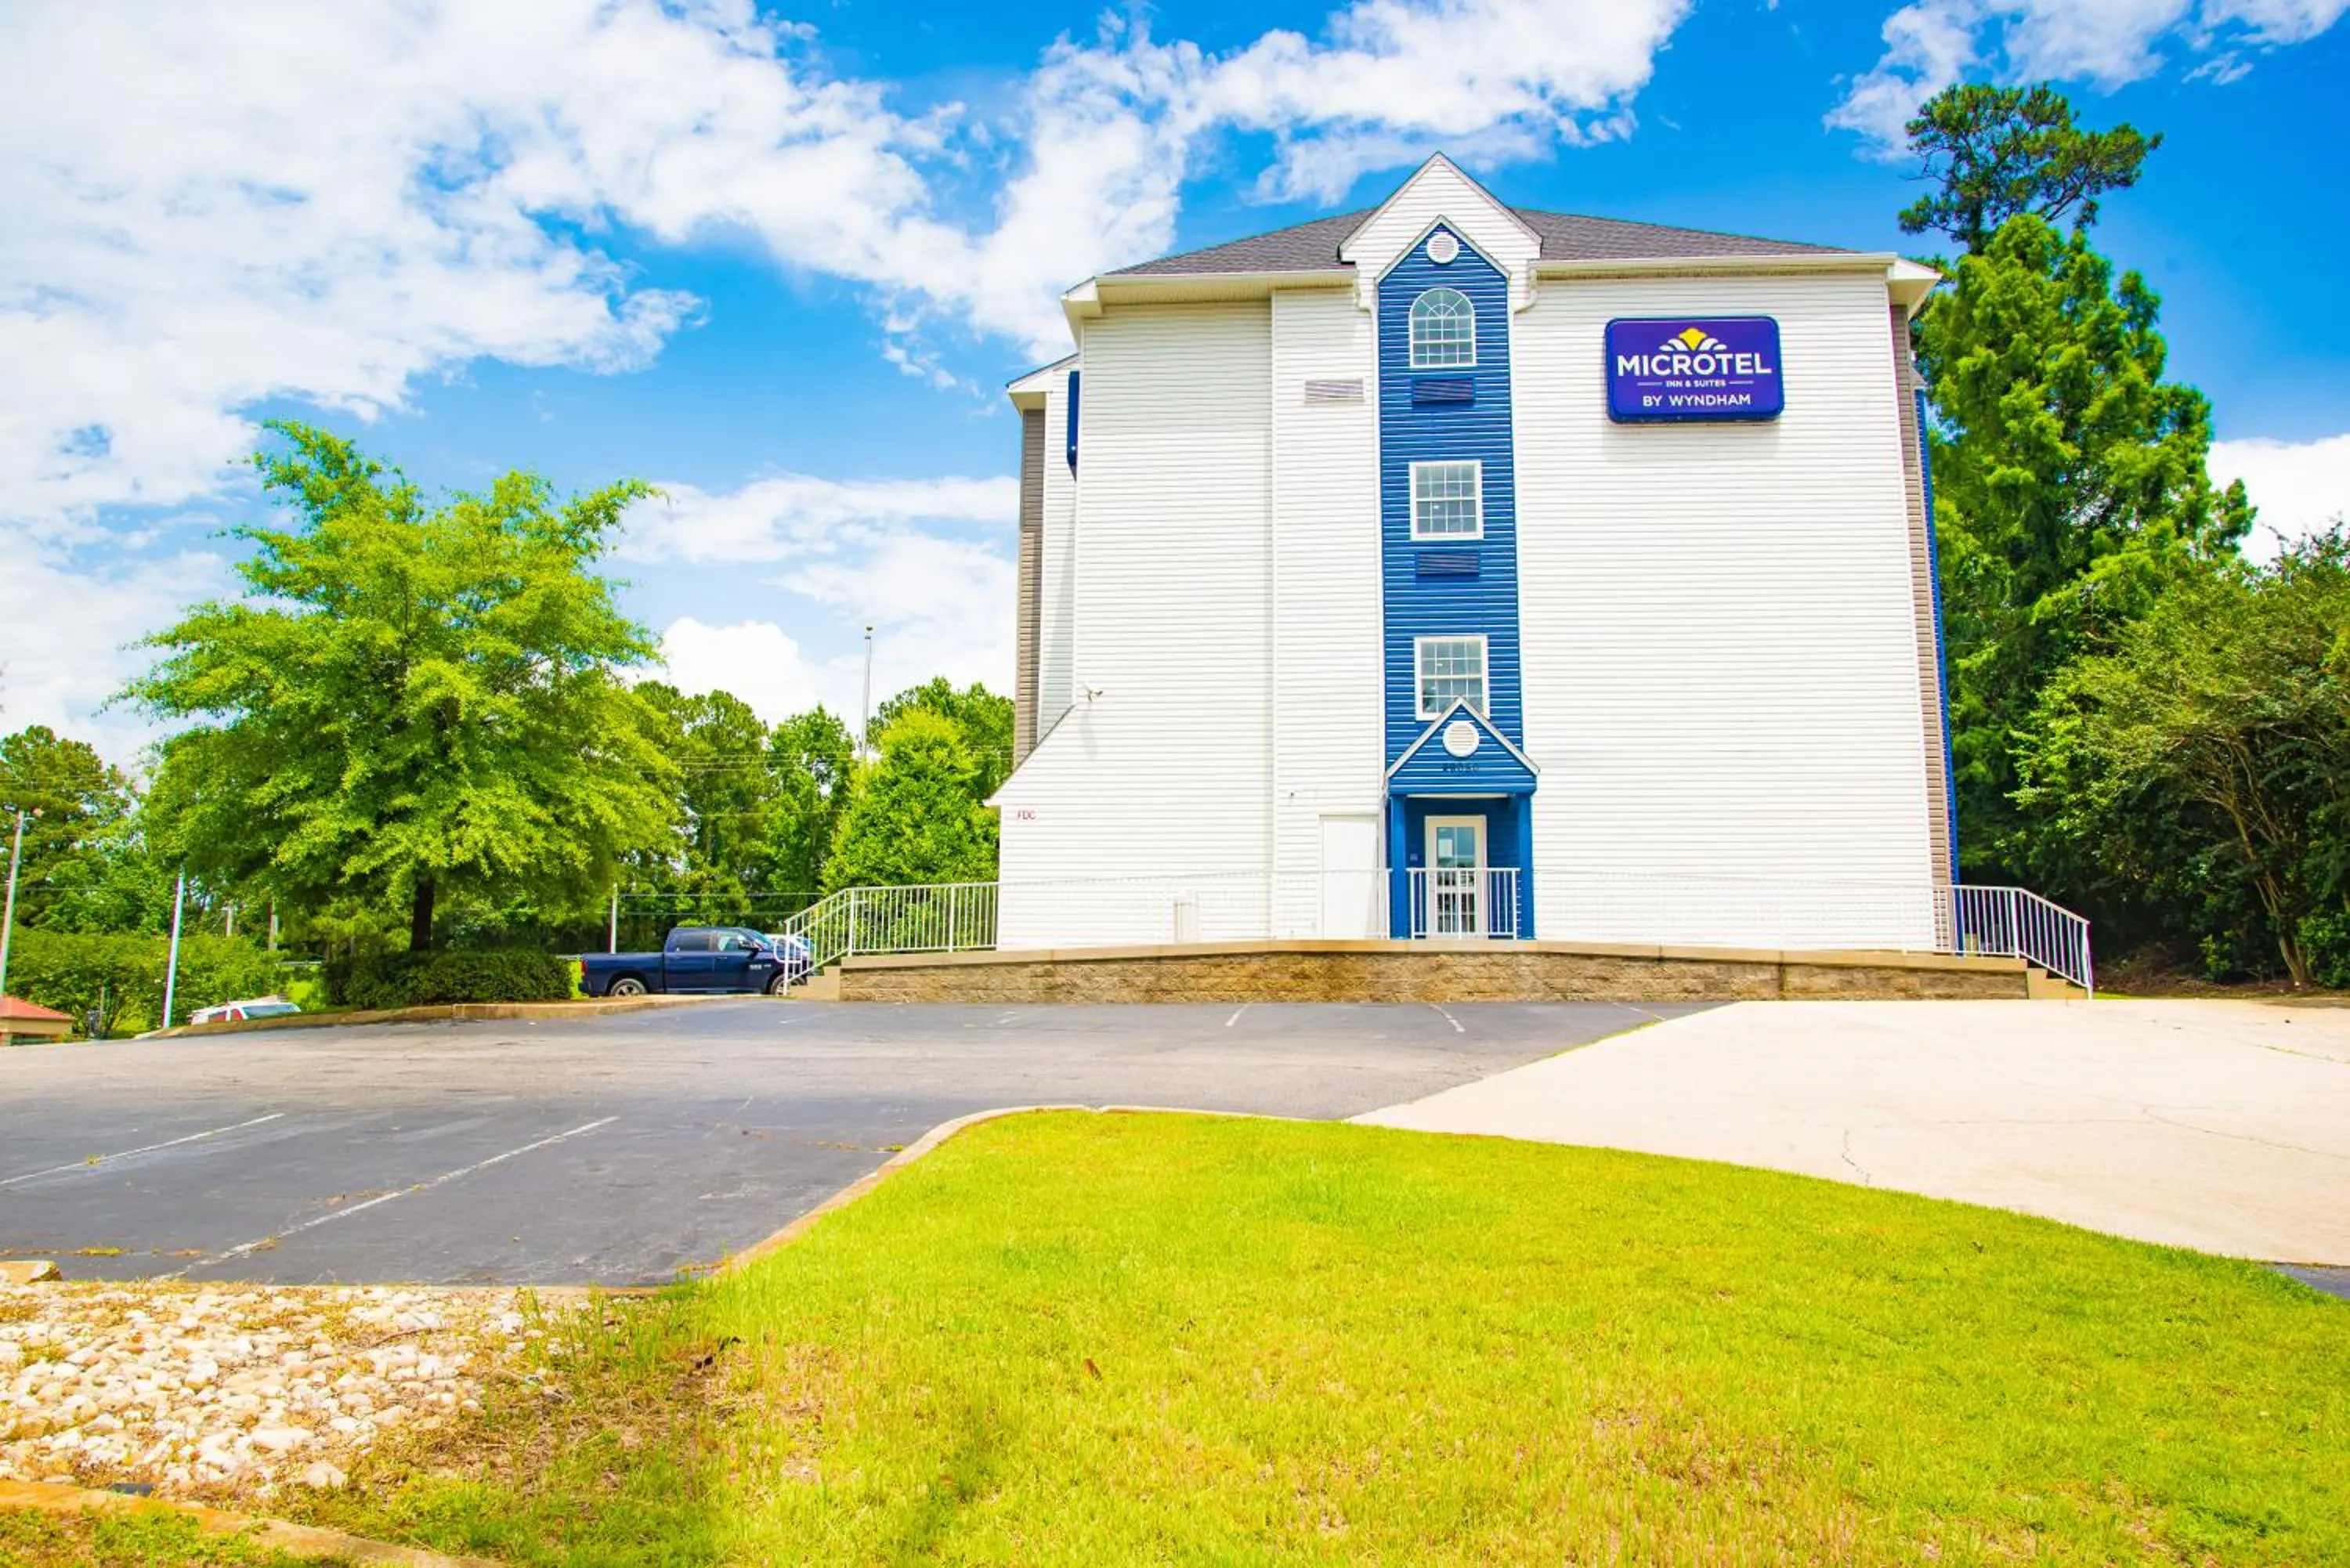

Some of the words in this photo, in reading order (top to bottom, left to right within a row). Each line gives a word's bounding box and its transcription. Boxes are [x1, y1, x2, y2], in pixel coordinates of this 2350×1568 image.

[1617, 352, 1773, 376] MICROTEL
[1694, 379, 1726, 388] SUITES
[1643, 395, 1661, 406] BY
[1669, 394, 1751, 406] WYNDHAM
[1018, 811, 1036, 820] FDC
